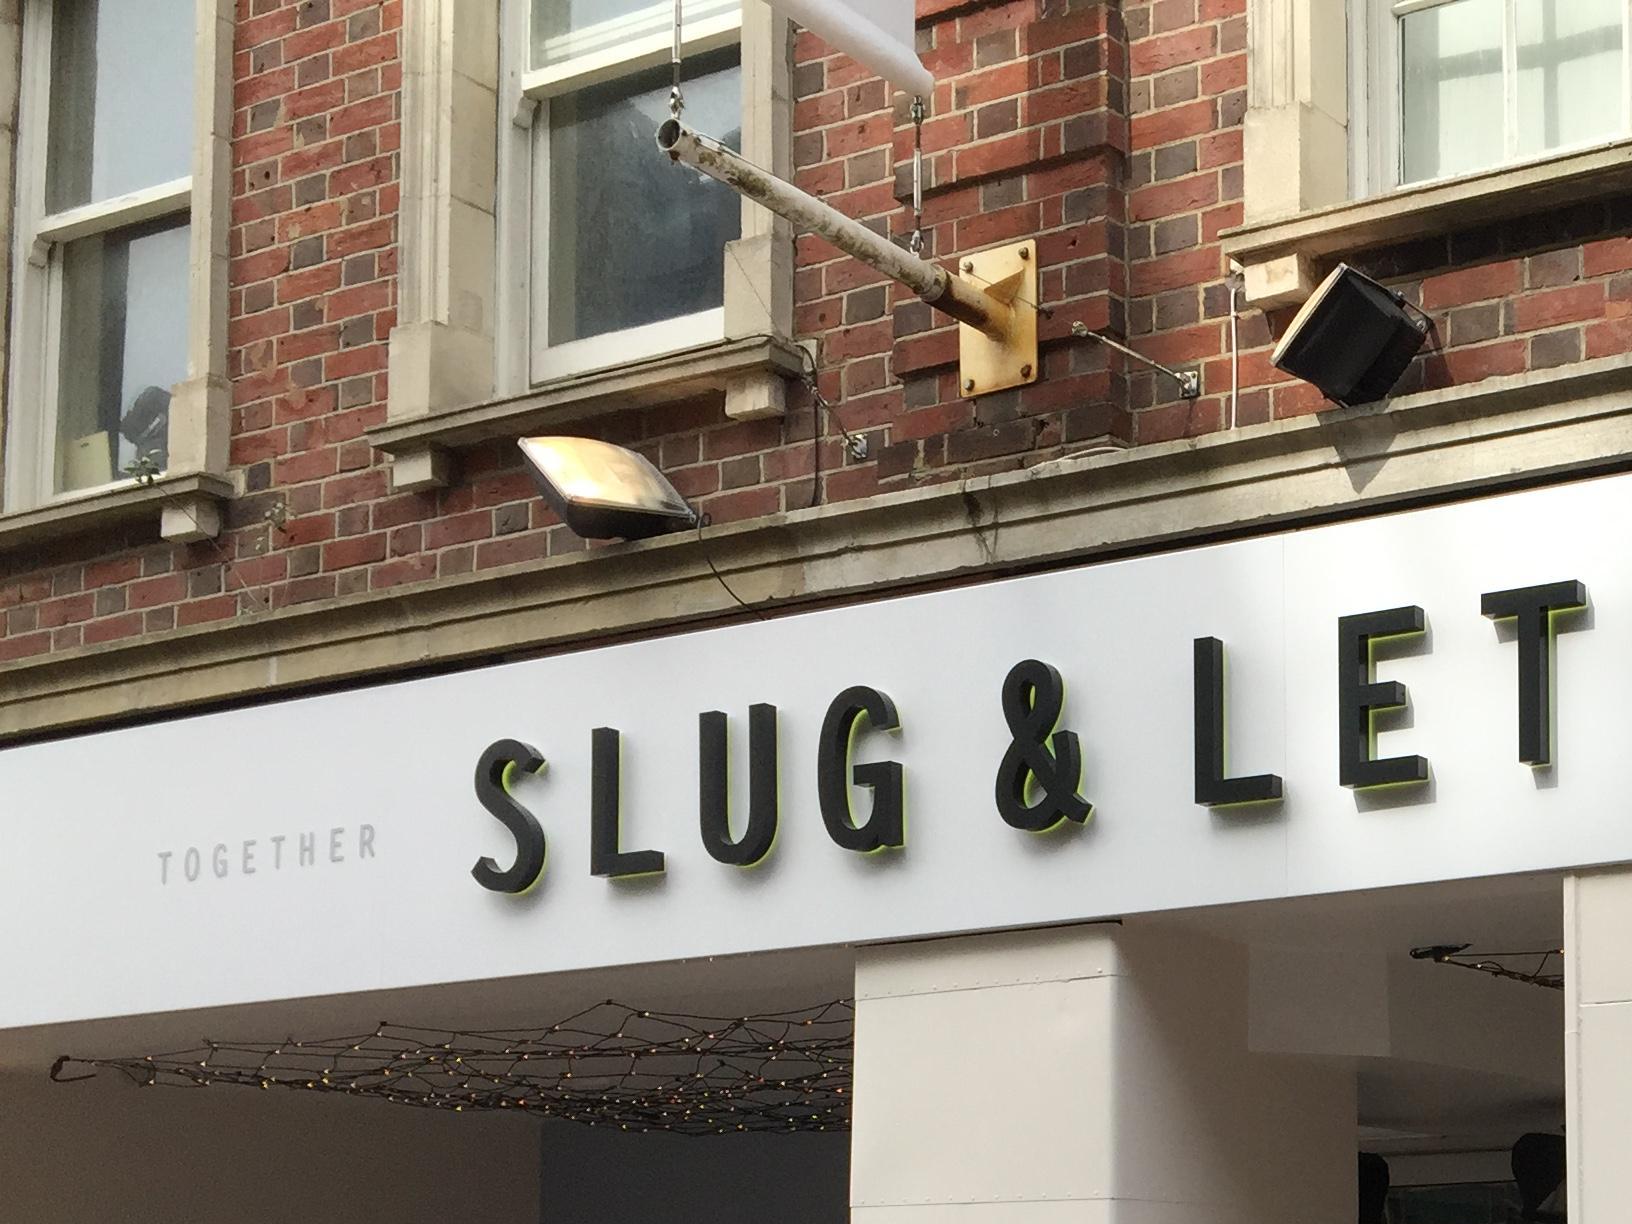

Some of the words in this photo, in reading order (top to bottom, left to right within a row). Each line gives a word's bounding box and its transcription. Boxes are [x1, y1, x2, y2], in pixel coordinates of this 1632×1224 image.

[470, 685, 906, 896] SLUG
[995, 657, 1096, 833] &
[156, 822, 377, 886] TOGETHER
